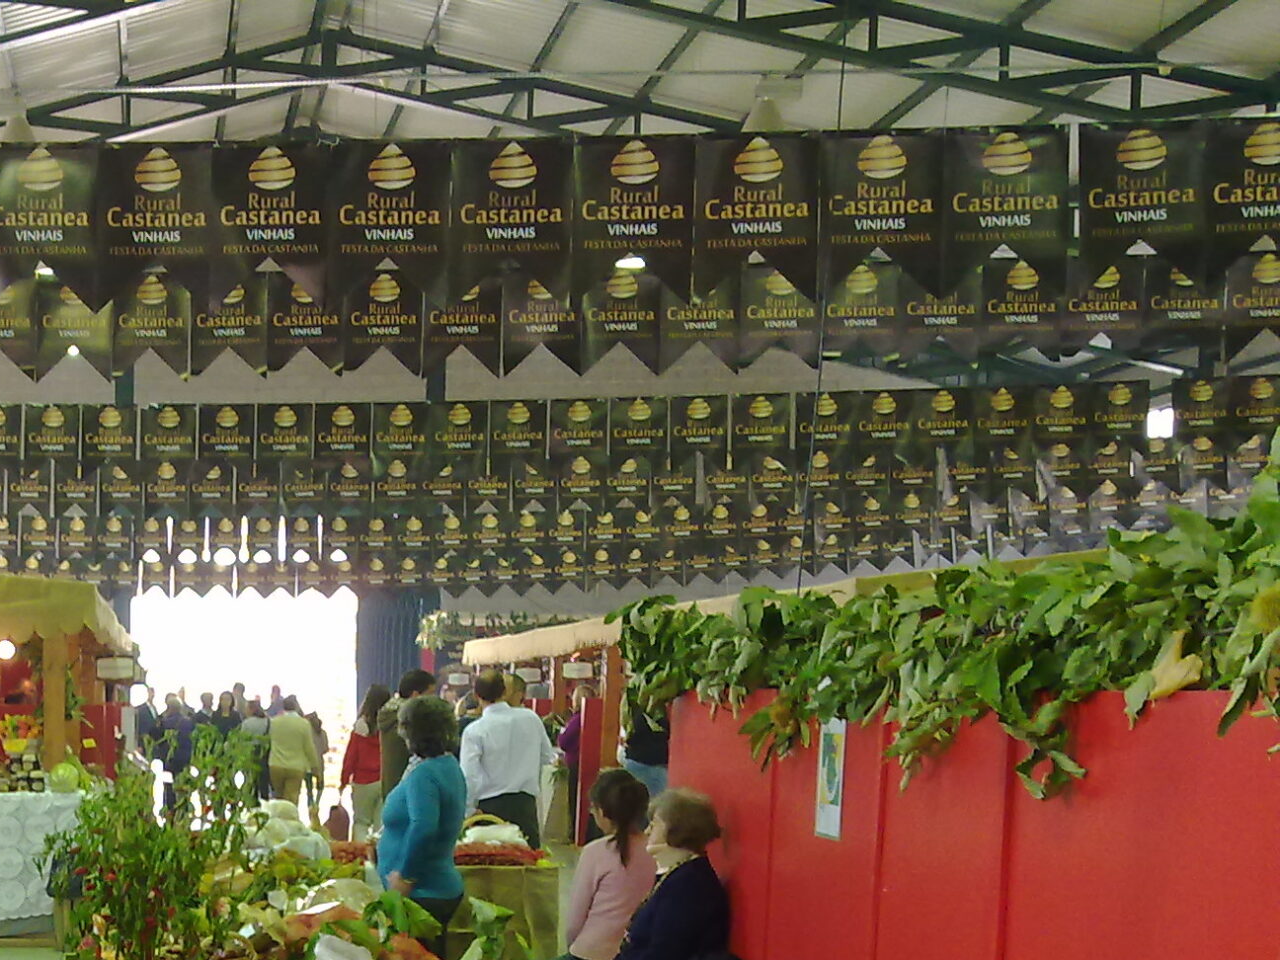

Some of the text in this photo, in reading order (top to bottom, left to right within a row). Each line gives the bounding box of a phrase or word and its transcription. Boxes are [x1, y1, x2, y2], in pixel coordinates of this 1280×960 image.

[981, 175, 1031, 195] Rural
[1116, 169, 1167, 190] Rural
[610, 185, 658, 203] Rural
[734, 182, 783, 201] Rural
[857, 179, 906, 198] Rural
[1086, 181, 1195, 209] Castanea
[17, 192, 63, 209] Rural
[134, 192, 181, 210] Rural
[248, 190, 295, 208] Rural
[367, 190, 415, 208] Rural
[488, 188, 536, 207] Rural
[827, 192, 933, 215] Castanea
[951, 188, 1059, 213] Castanea
[220, 204, 321, 225] Castanea
[339, 204, 440, 225] Castanea
[459, 202, 562, 224] Castanea
[581, 198, 684, 220] Castanea
[704, 195, 809, 219] Castanea
[106, 206, 206, 227] Castanea
[978, 213, 1032, 227] VINHAIS
[1114, 207, 1168, 223] VINHAIS
[607, 222, 658, 235] VINHAIS
[731, 220, 783, 234] VINHAIS
[854, 216, 906, 230] VINHAIS
[14, 229, 64, 241] VINHAIS
[132, 229, 181, 242] VINHAIS
[245, 227, 295, 240] VINHAIS
[364, 227, 414, 240] VINHAIS
[485, 225, 536, 239] VINHAIS
[907, 301, 974, 315] Castanea
[987, 299, 1055, 313] Castanea
[1068, 297, 1137, 311] Castanea
[1150, 295, 1218, 309] Castanea
[429, 310, 495, 324] Castanea
[509, 308, 575, 323] Castanea
[587, 307, 654, 321] Castanea
[667, 306, 734, 320] Castanea
[747, 304, 814, 318] Castanea
[827, 303, 894, 317] Castanea
[118, 313, 183, 328] Castanea
[196, 312, 261, 327] Castanea
[273, 312, 338, 326] Castanea
[351, 311, 416, 325] Castanea
